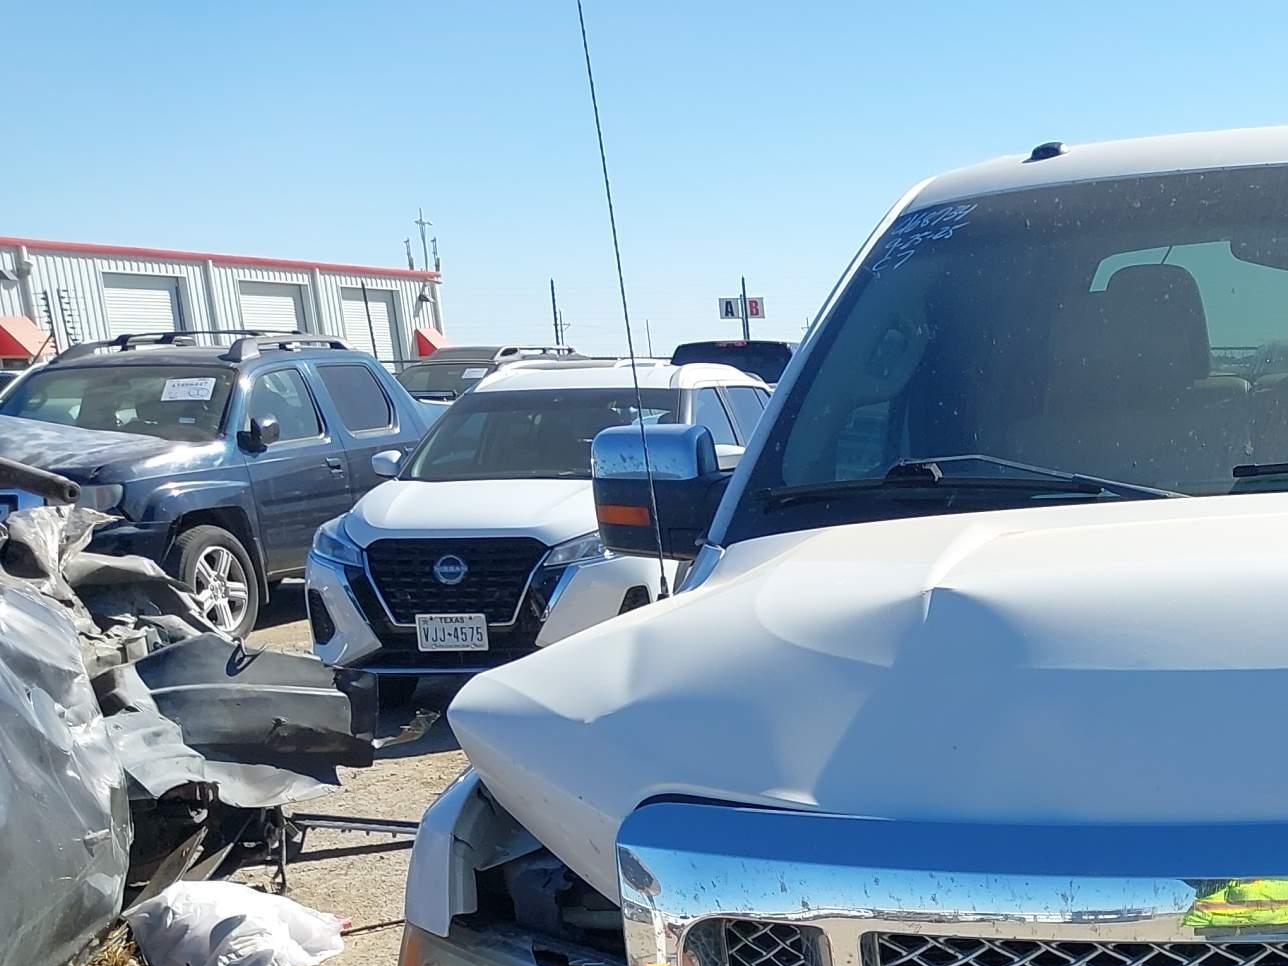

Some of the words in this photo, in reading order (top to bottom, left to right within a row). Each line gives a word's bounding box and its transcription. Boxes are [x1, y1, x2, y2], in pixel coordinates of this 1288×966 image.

[725, 300, 735, 317] A
[749, 300, 759, 316] B
[439, 616, 465, 624] TEXAS
